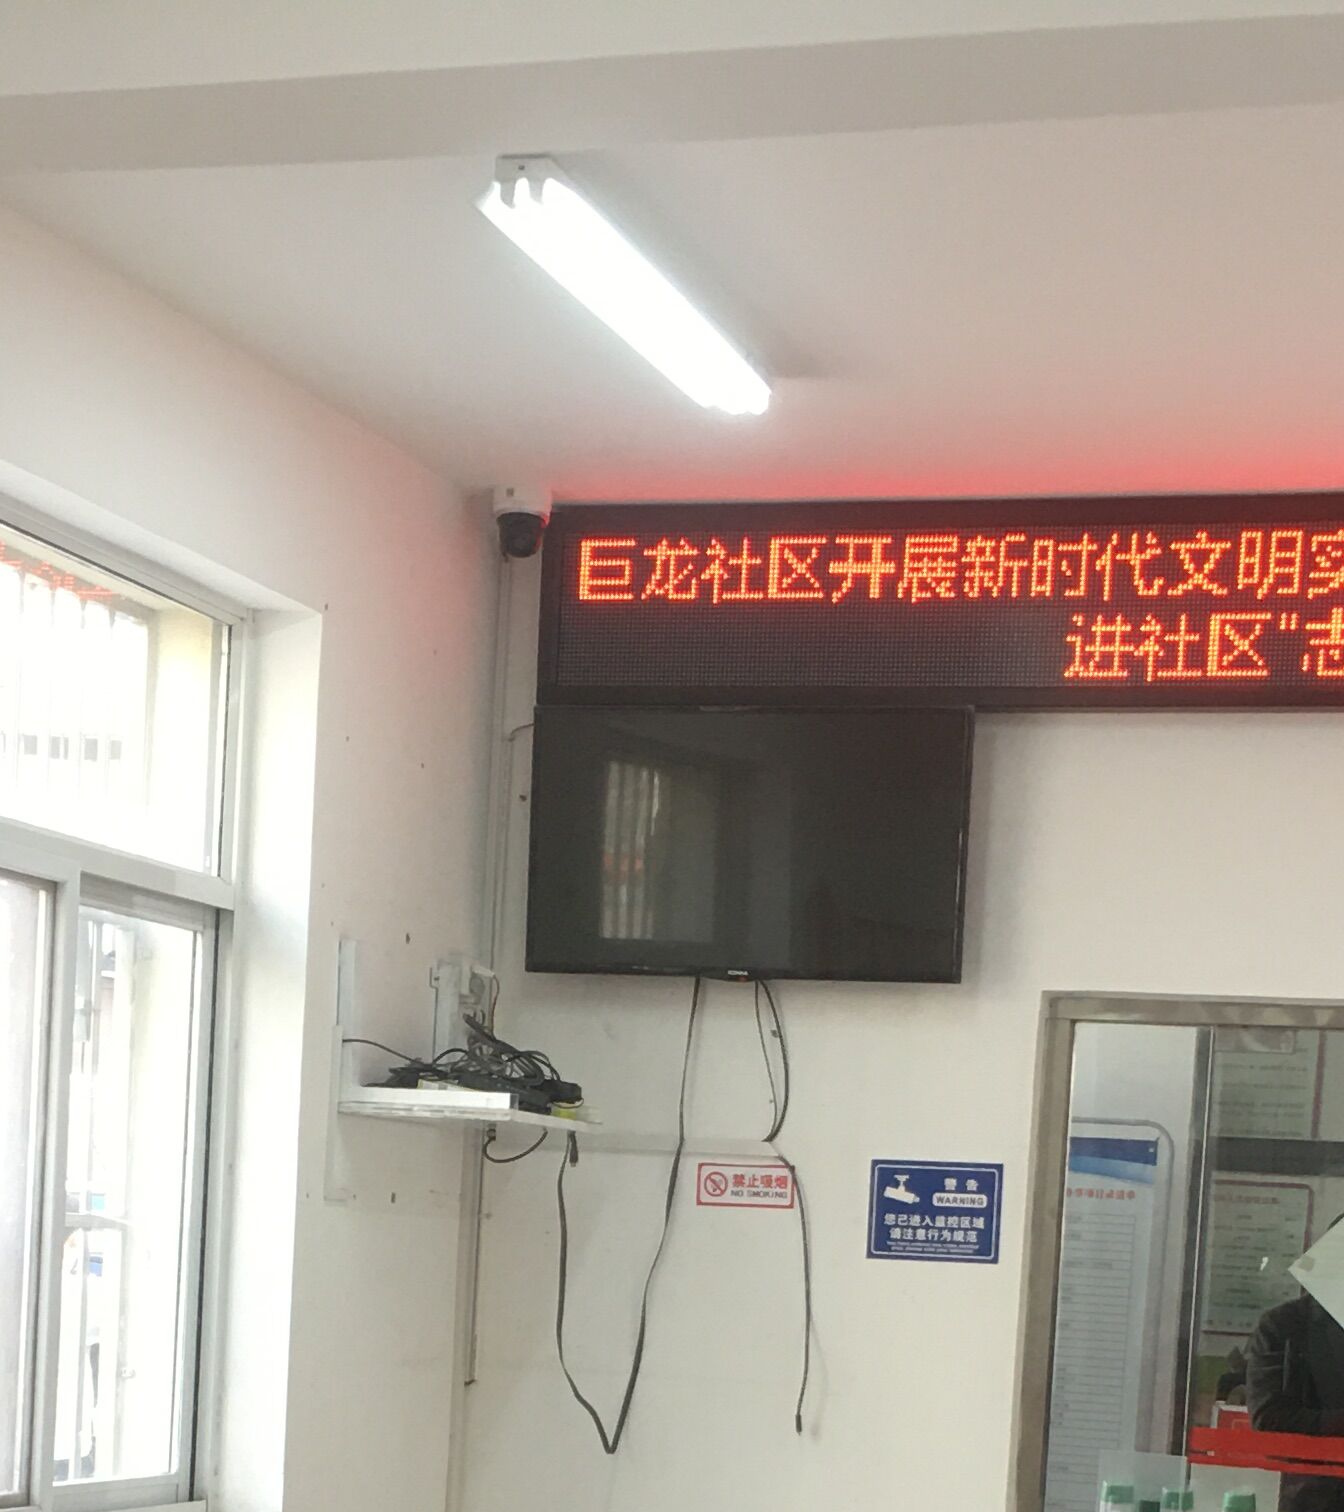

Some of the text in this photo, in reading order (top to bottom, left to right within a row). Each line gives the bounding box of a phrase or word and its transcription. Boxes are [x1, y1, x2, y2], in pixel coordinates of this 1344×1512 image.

[732, 1173, 788, 1189] 禁止吸烟
[730, 1189, 788, 1199] NO SMOKING
[935, 1195, 985, 1206] WARNING
